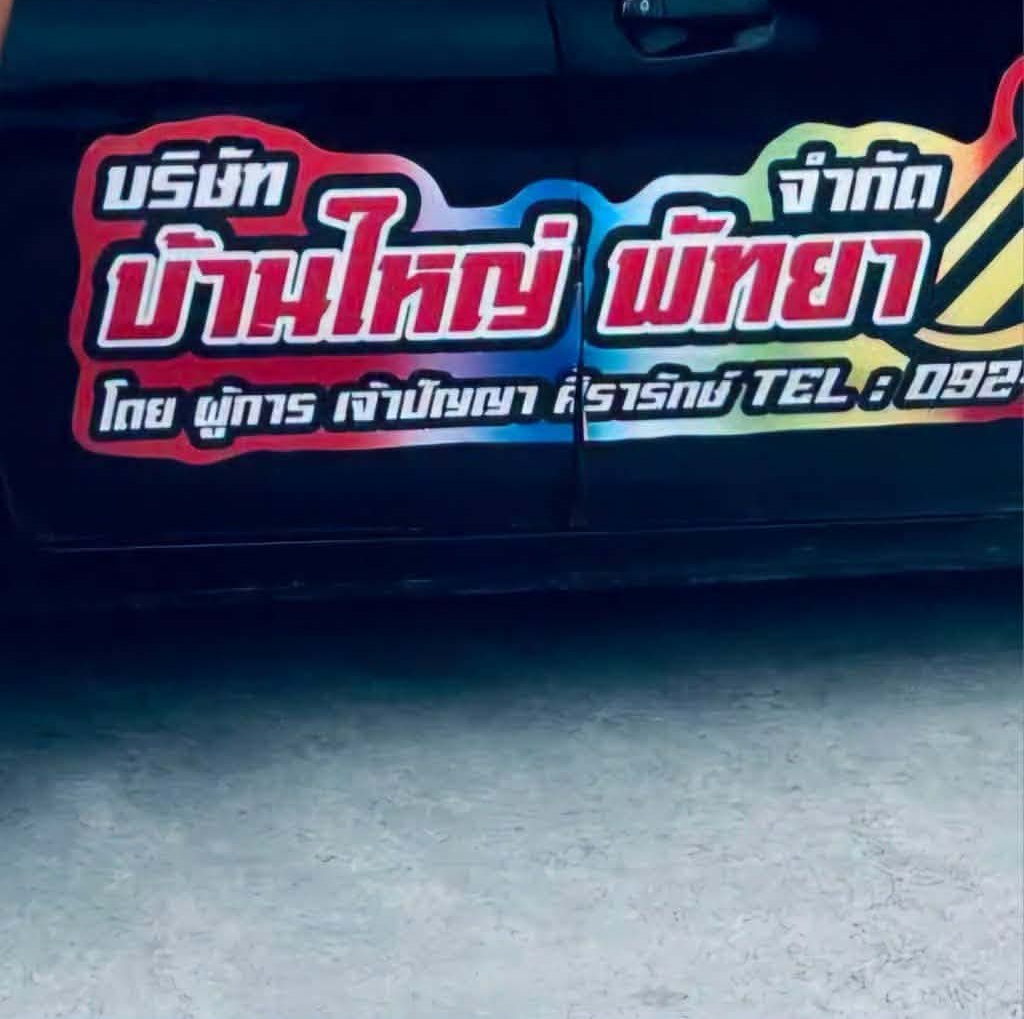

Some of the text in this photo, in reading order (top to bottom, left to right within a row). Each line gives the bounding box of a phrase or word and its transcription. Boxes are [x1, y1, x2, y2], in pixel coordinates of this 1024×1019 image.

[102, 147, 289, 211] บริษัท
[778, 150, 943, 214] จำกัด
[97, 188, 931, 347] บ้านใหญ่ พัทยา
[99, 379, 177, 432] โดย
[193, 386, 318, 440] ผู้การ
[332, 379, 539, 423] เจ้าปัญญา
[904, 359, 1024, 401] 092
